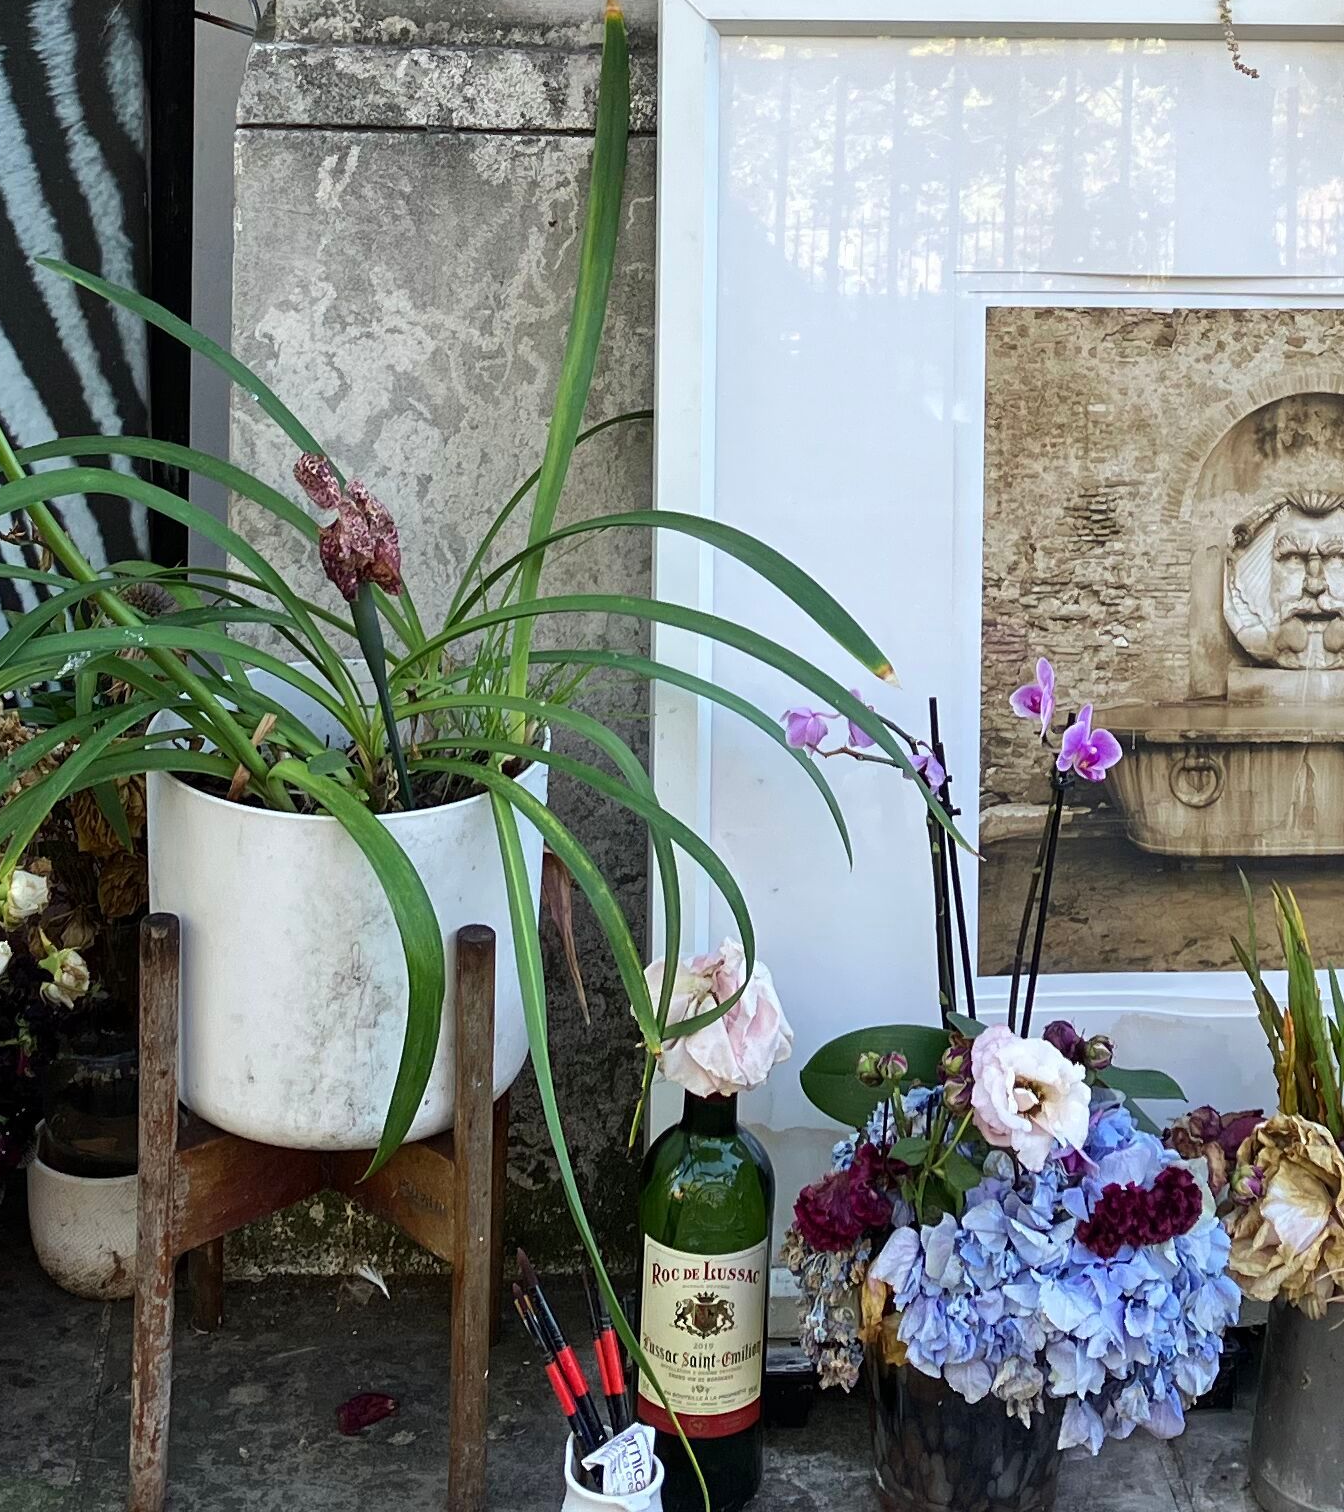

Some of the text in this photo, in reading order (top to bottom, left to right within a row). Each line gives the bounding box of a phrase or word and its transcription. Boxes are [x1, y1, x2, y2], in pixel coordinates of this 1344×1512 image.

[652, 1259, 760, 1287] ROC DE LUSSAC
